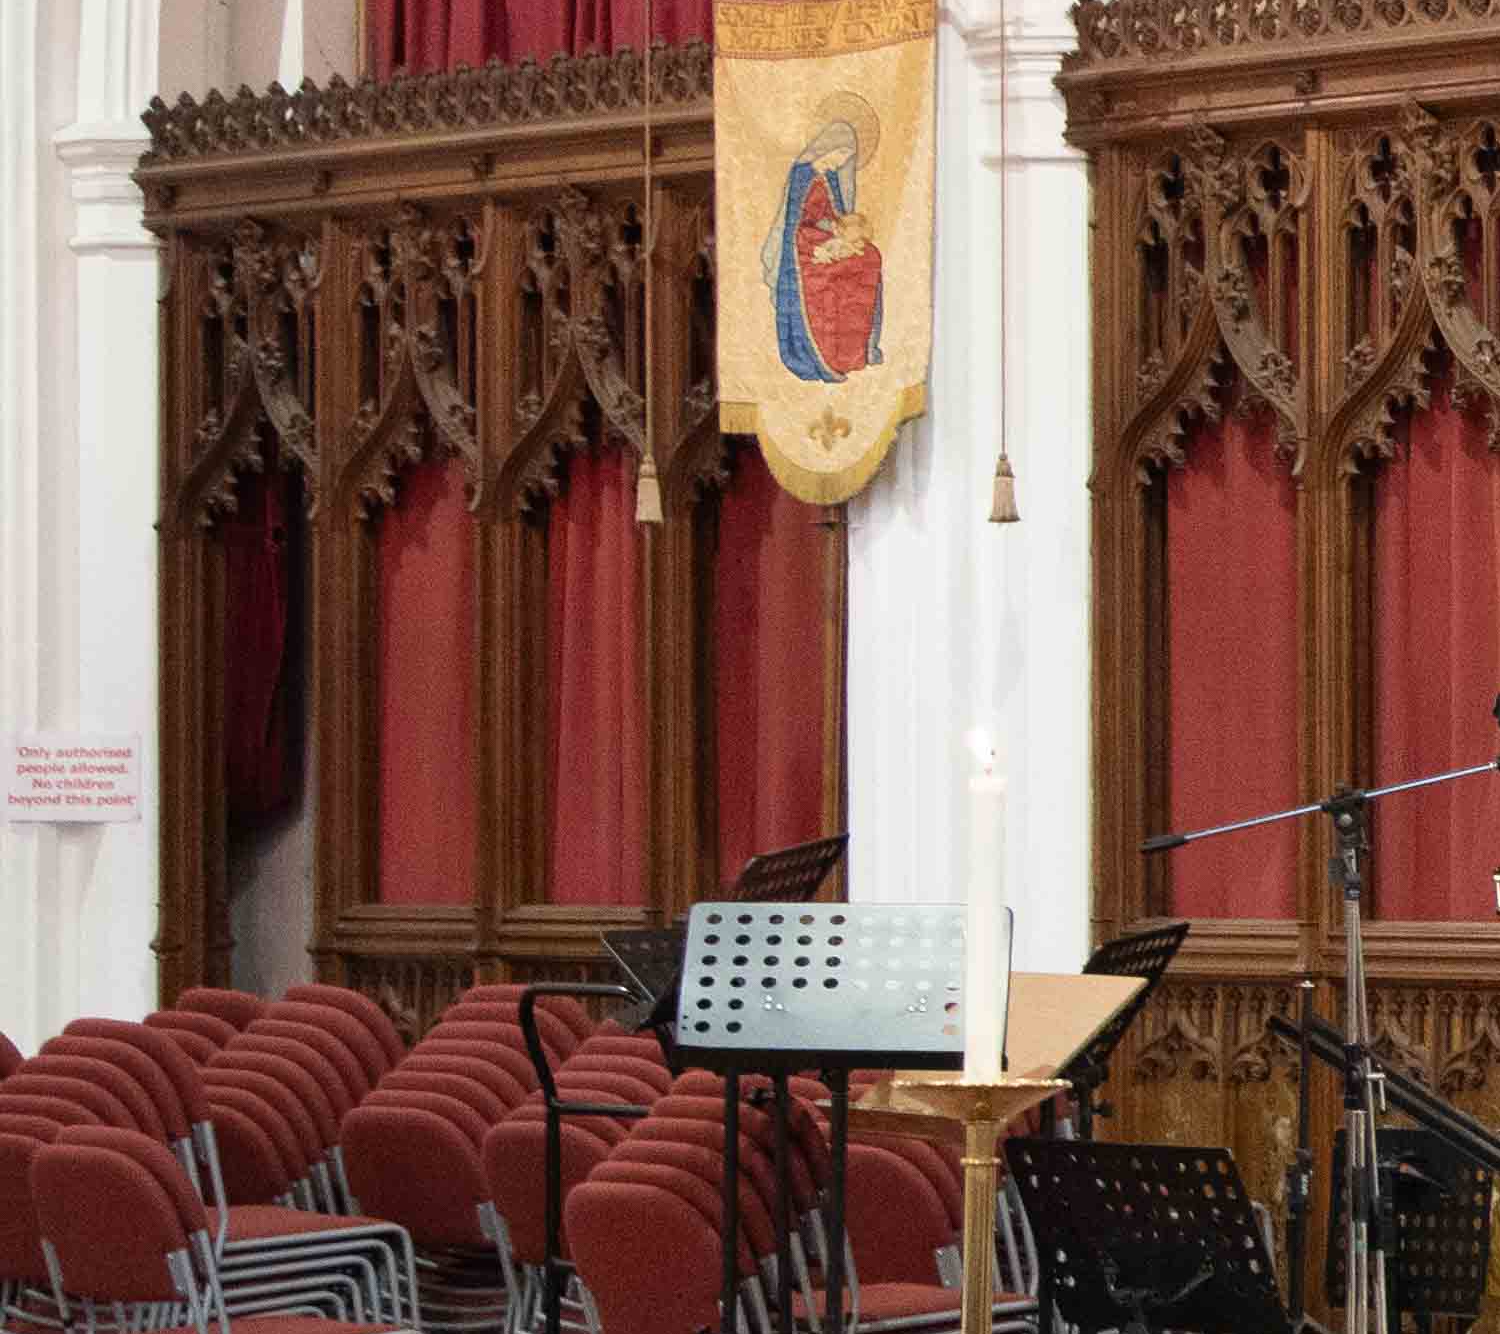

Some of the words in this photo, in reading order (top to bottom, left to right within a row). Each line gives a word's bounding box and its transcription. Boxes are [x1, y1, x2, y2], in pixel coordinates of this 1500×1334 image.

[16, 763, 65, 776] people
[32, 779, 51, 789] No
[56, 778, 114, 789] children
[8, 794, 61, 809] beyond
[66, 794, 92, 805] this
